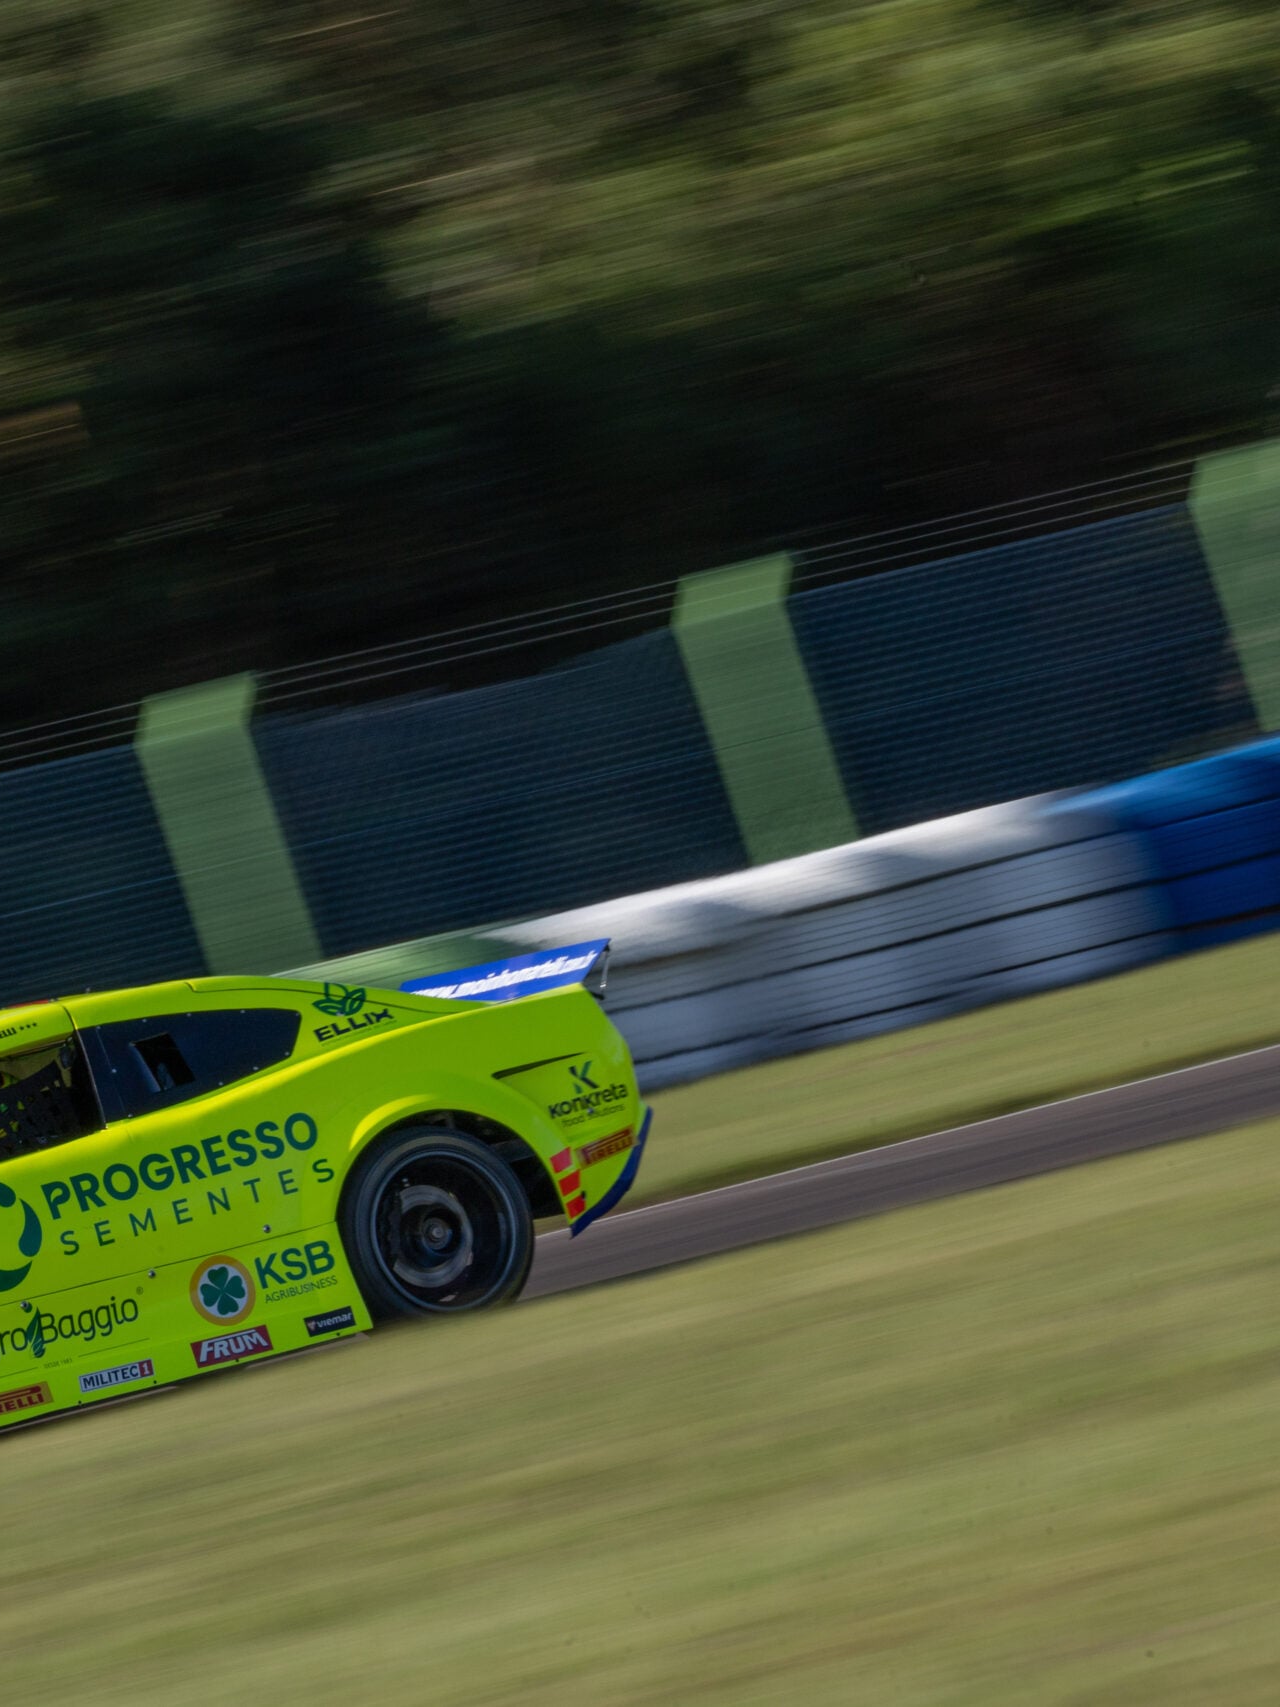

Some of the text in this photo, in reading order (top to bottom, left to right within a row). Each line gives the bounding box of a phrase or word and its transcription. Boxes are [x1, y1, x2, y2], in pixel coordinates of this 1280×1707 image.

[313, 1008, 395, 1042] ELLIX
[41, 1112, 319, 1220] PROGRESSO
[581, 1127, 635, 1166] PIRELLI
[59, 1158, 335, 1256] SEMENTES
[254, 1240, 336, 1290] KSB
[265, 1275, 338, 1304] AGRIBUSINESS
[39, 1296, 139, 1345] Baggio
[199, 1329, 269, 1363] FRUM
[82, 1365, 139, 1389] MILITEC
